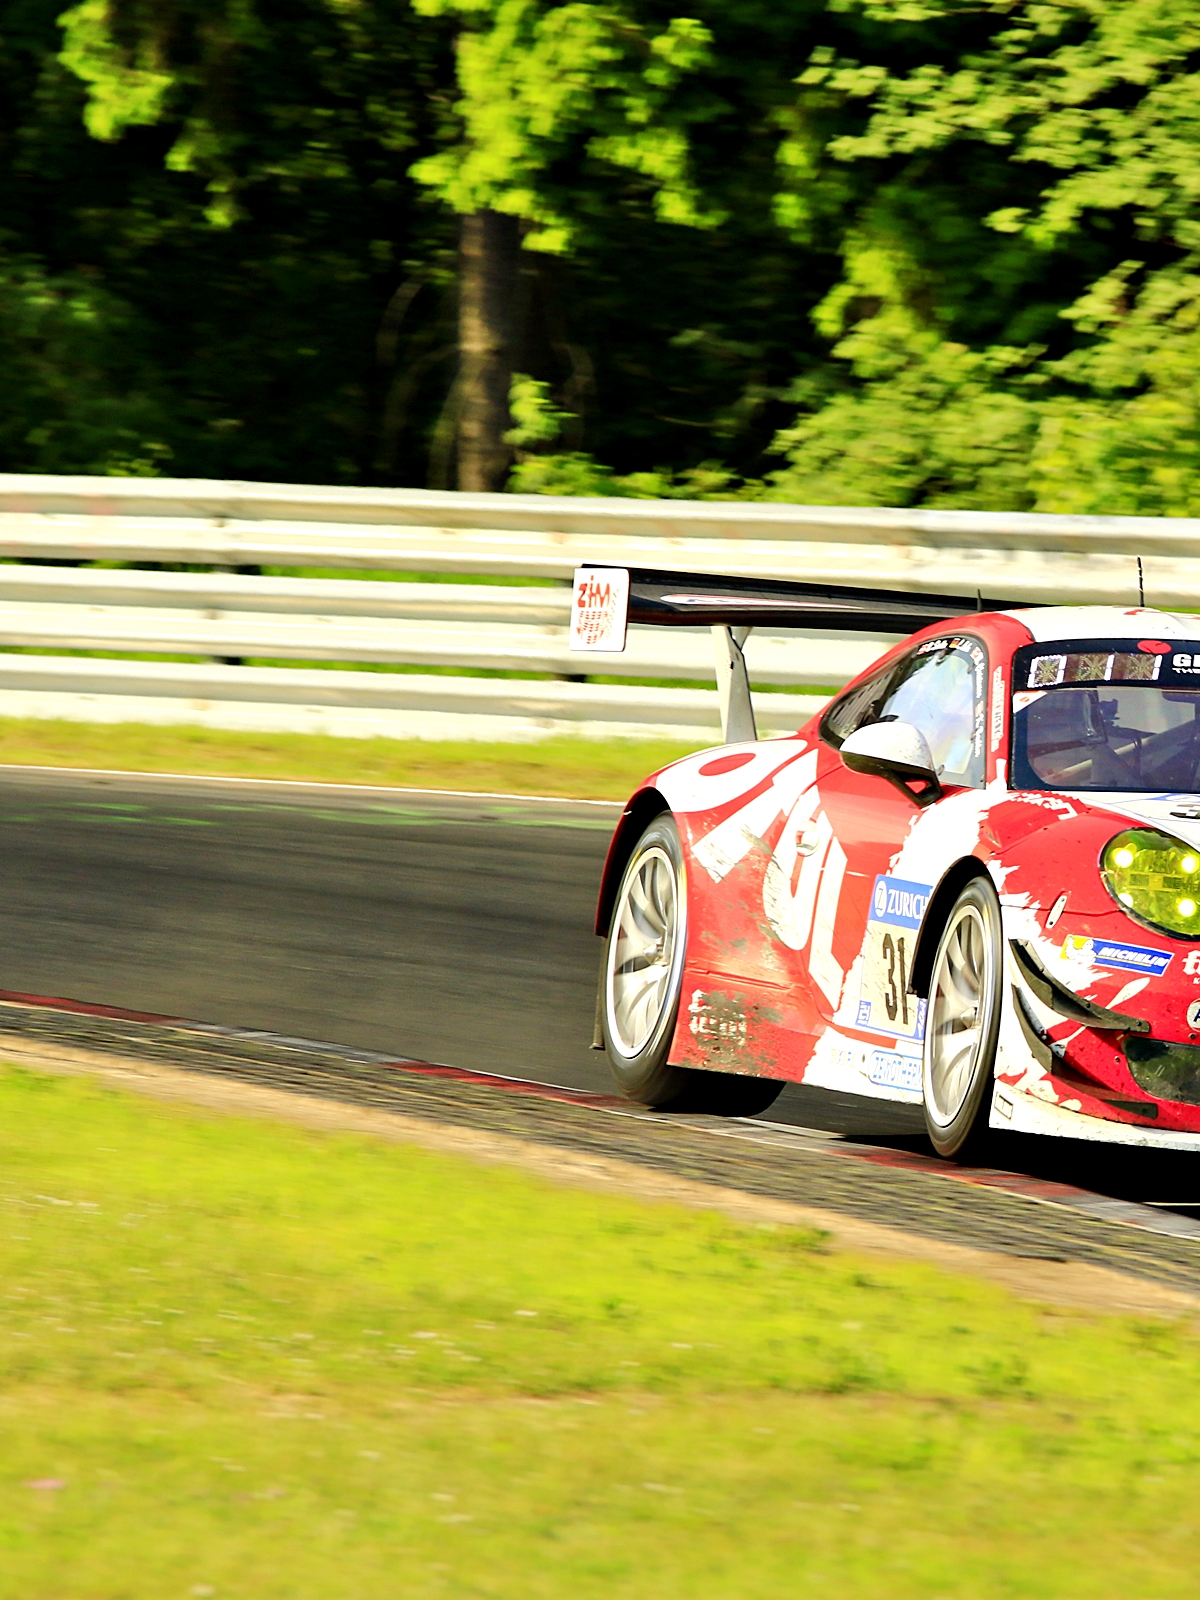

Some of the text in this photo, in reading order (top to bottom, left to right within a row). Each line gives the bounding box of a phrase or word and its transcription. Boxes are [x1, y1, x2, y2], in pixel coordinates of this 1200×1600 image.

[887, 889, 926, 920] ZURICH
[1099, 946, 1170, 967] MICHELIN
[882, 933, 909, 1025] 31
